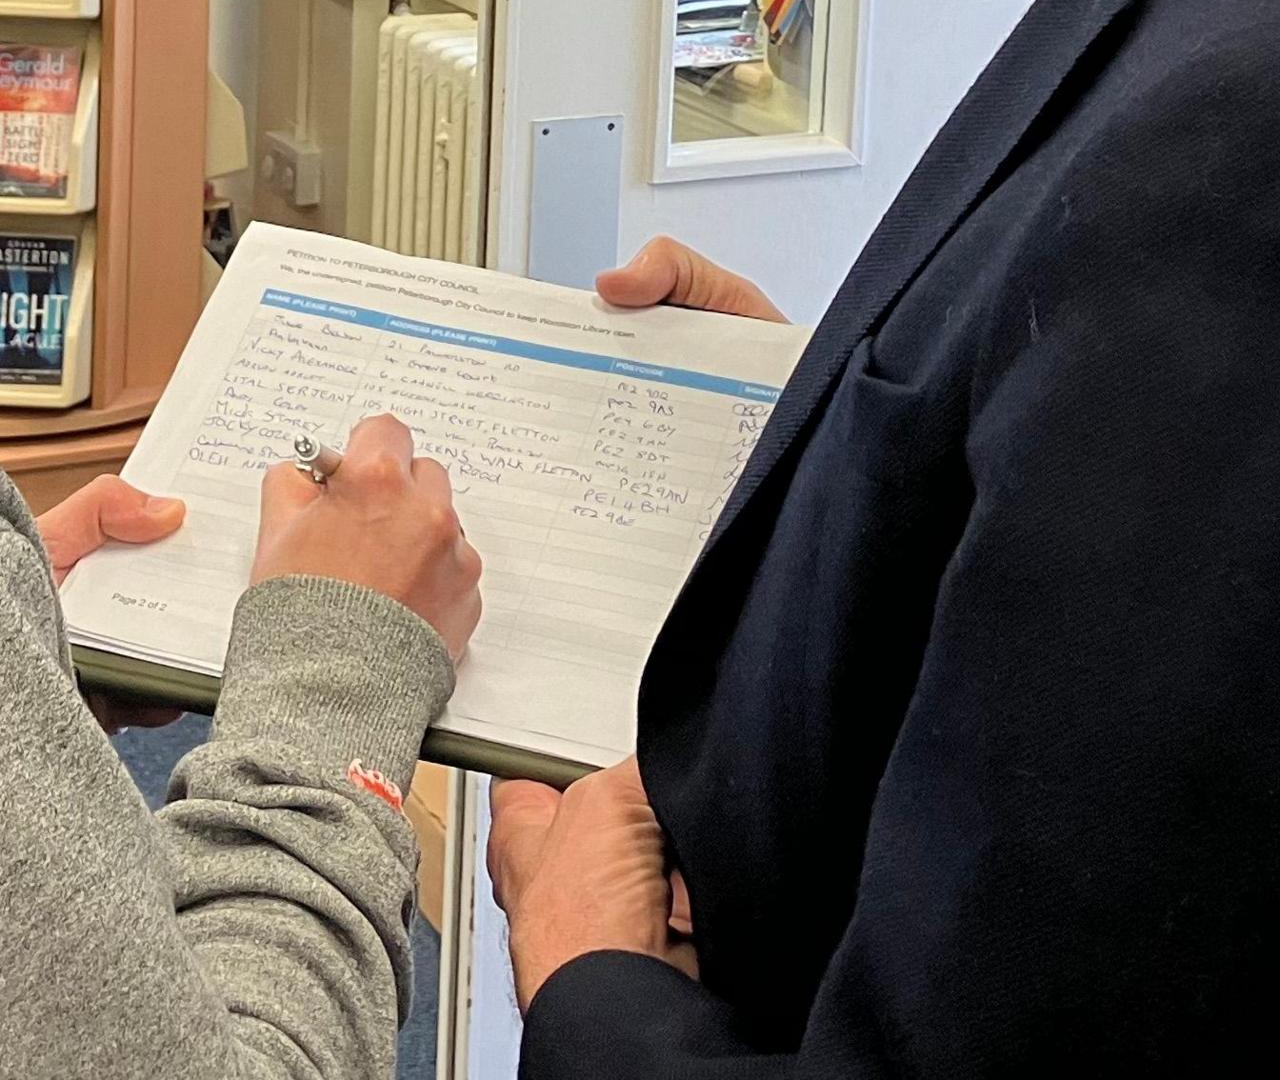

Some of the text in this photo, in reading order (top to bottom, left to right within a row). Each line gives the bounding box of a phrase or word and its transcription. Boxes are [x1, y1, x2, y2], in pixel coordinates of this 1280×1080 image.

[287, 249, 328, 264] PETITION
[343, 260, 417, 281] PETERBOROUGH
[417, 274, 439, 287] CITY
[439, 278, 479, 295] COUNCIL
[265, 293, 290, 304] NAME
[397, 286, 454, 307] Peterborough
[455, 299, 474, 312] City
[474, 303, 505, 318] Council
[581, 321, 612, 338] Library
[390, 405, 423, 417] HIGH
[492, 423, 560, 443] FLETTON
[112, 592, 137, 606] Page
[147, 601, 159, 609] of
